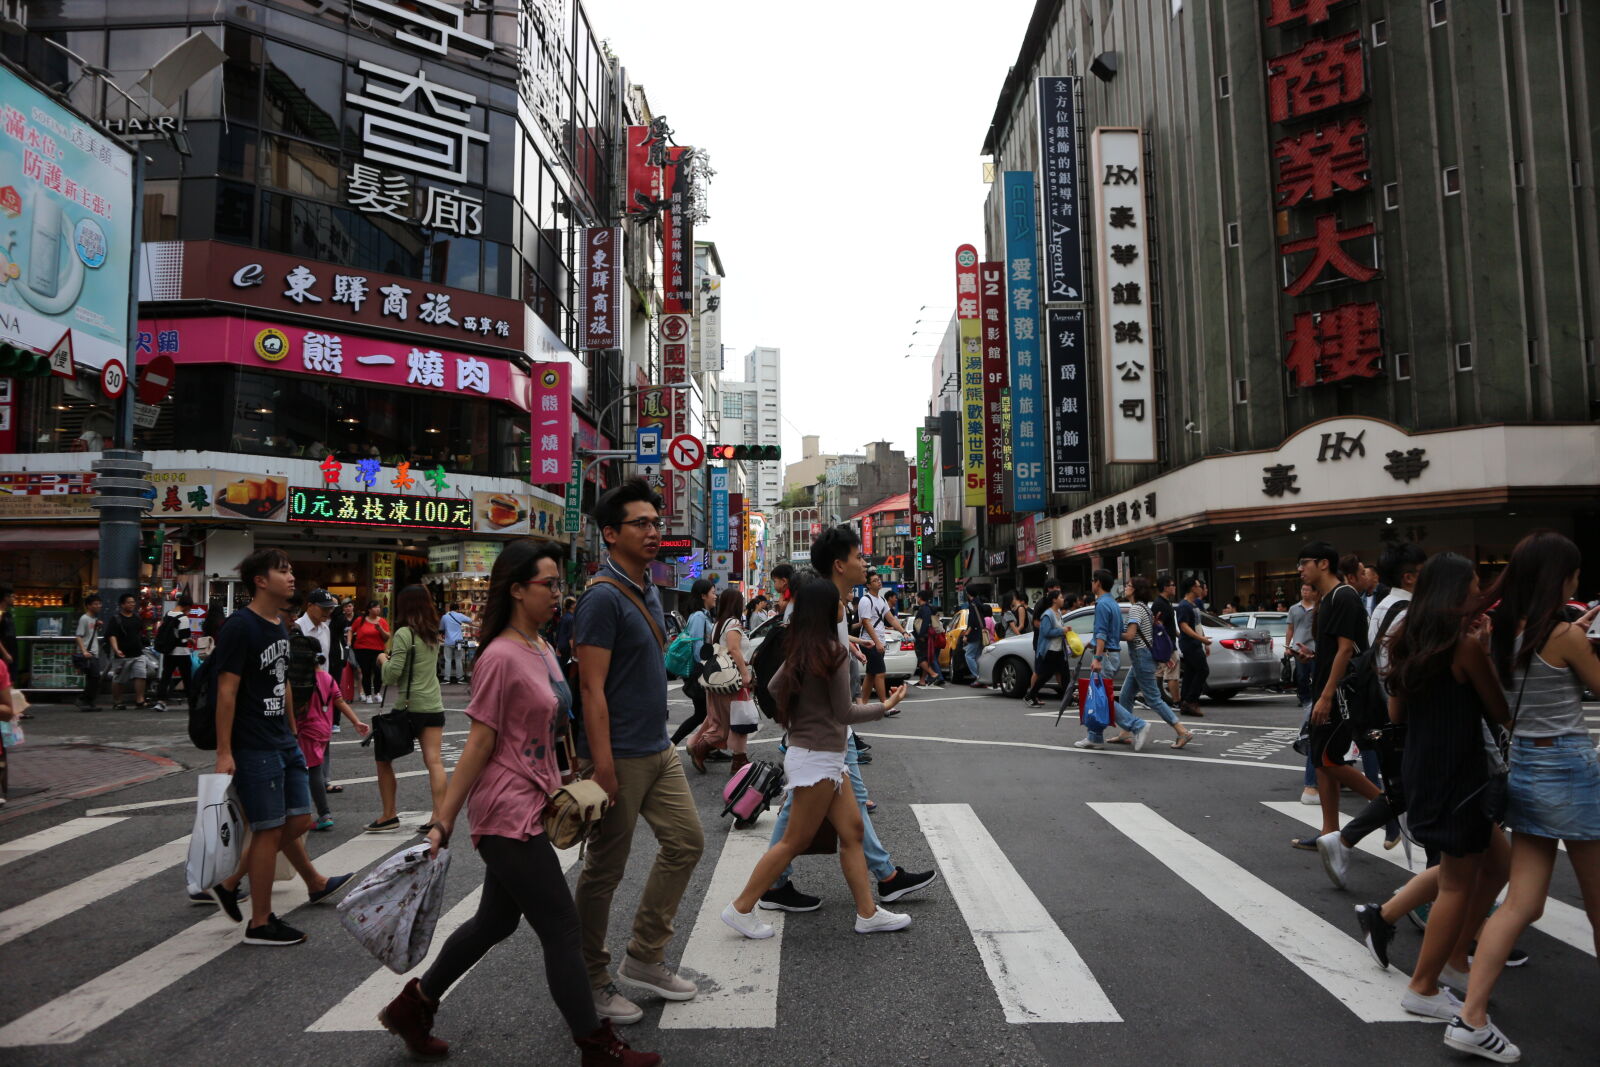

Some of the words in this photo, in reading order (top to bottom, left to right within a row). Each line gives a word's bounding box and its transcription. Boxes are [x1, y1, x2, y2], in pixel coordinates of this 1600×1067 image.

[347, 163, 482, 235] 髮廊
[284, 265, 459, 327] 東驛商旅
[463, 316, 510, 337] 西寧館
[590, 249, 611, 334] 東驛商旅
[958, 273, 979, 319] 萬年
[983, 270, 999, 295] U2
[986, 308, 1001, 360] 電影館
[1012, 258, 1035, 438] 愛客發時尚旅館
[107, 370, 120, 388] 30
[302, 331, 490, 393] 熊一燒肉
[965, 356, 985, 469] 湯姆熊歡樂世界
[1059, 331, 1079, 447] 安爵銀飾
[541, 394, 559, 474] 熊一燒肉
[320, 455, 450, 492] 台灣美味
[967, 473, 986, 489] 5F
[1017, 462, 1041, 479] 6F
[1261, 463, 1301, 498] 豪
[1383, 448, 1430, 485] 華
[293, 491, 471, 526] 0元荔枝凍100元
[263, 697, 281, 710] THE
